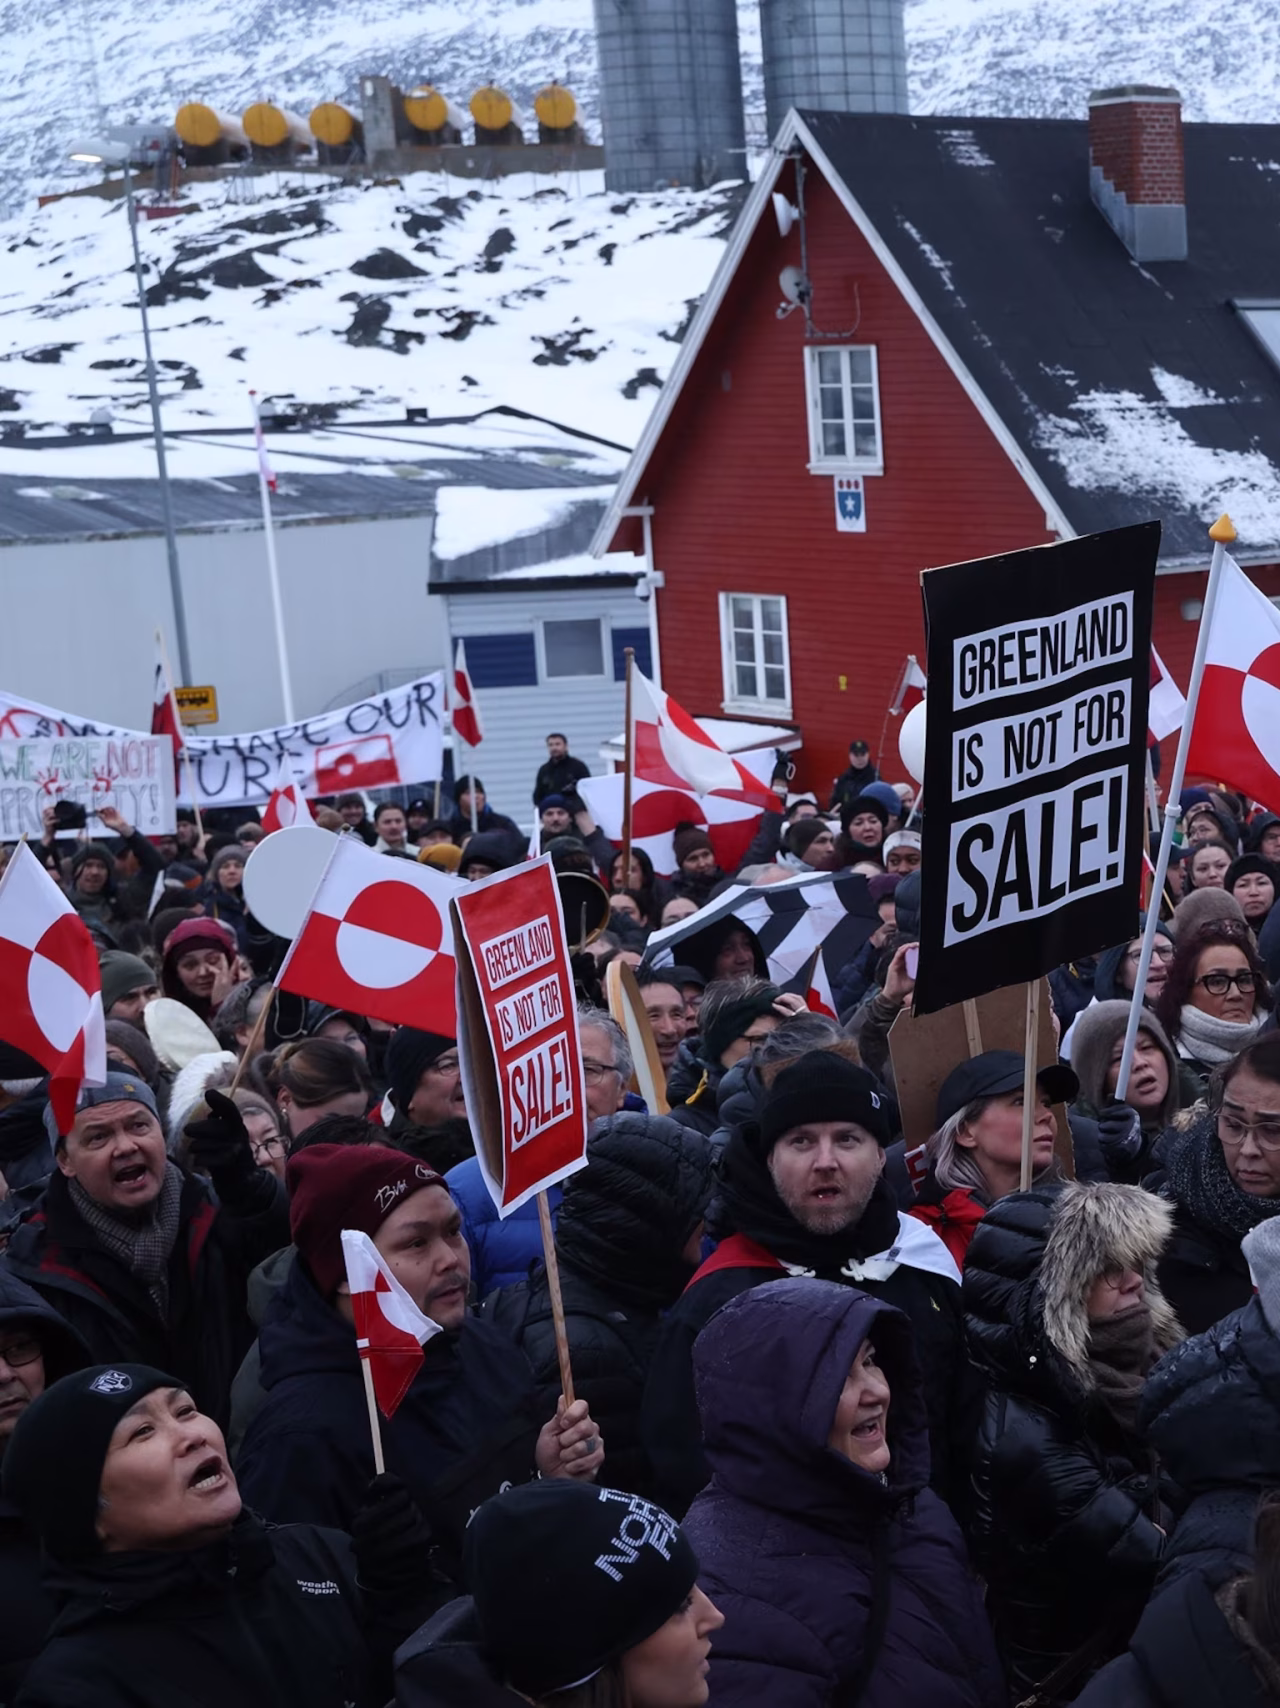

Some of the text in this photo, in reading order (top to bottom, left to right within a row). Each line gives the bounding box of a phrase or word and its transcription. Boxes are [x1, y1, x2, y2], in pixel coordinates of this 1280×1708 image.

[958, 601, 1128, 700] GREENLAND
[345, 681, 439, 734] OUR
[958, 689, 1125, 792] IS NOT FOR
[0, 740, 160, 781] WE ARE NOT
[952, 775, 1123, 933] SALE!
[485, 922, 553, 984] GREENLAND
[499, 980, 562, 1043] IS NOT FOR
[511, 1038, 572, 1144] SALE!
